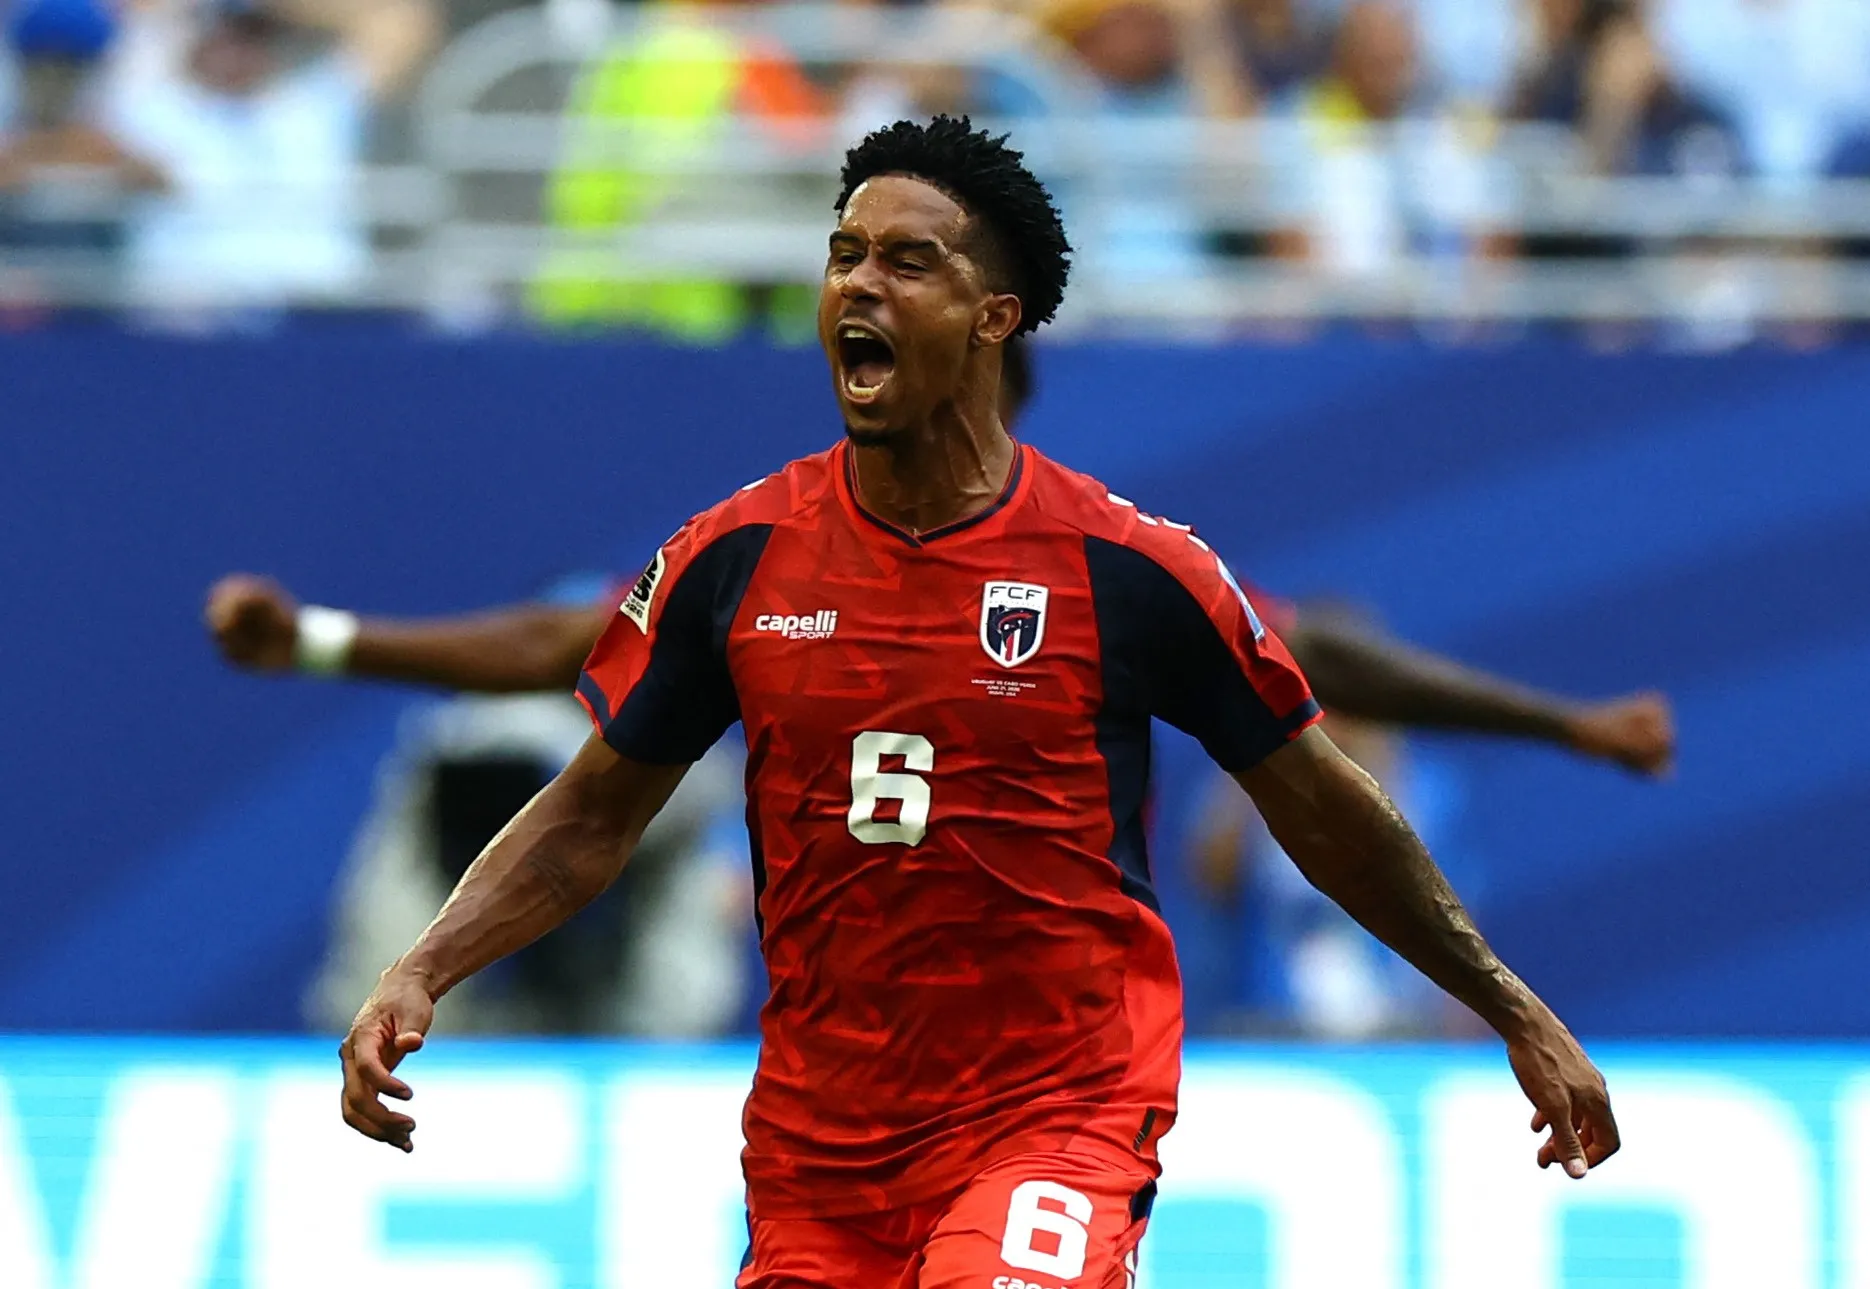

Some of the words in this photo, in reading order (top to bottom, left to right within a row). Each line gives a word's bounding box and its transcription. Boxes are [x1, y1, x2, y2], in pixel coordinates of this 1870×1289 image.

[990, 585, 1042, 600] FCF
[756, 610, 838, 637] capelli
[788, 631, 834, 640] SPORT
[847, 730, 935, 848] 6
[1000, 1180, 1094, 1280] 6
